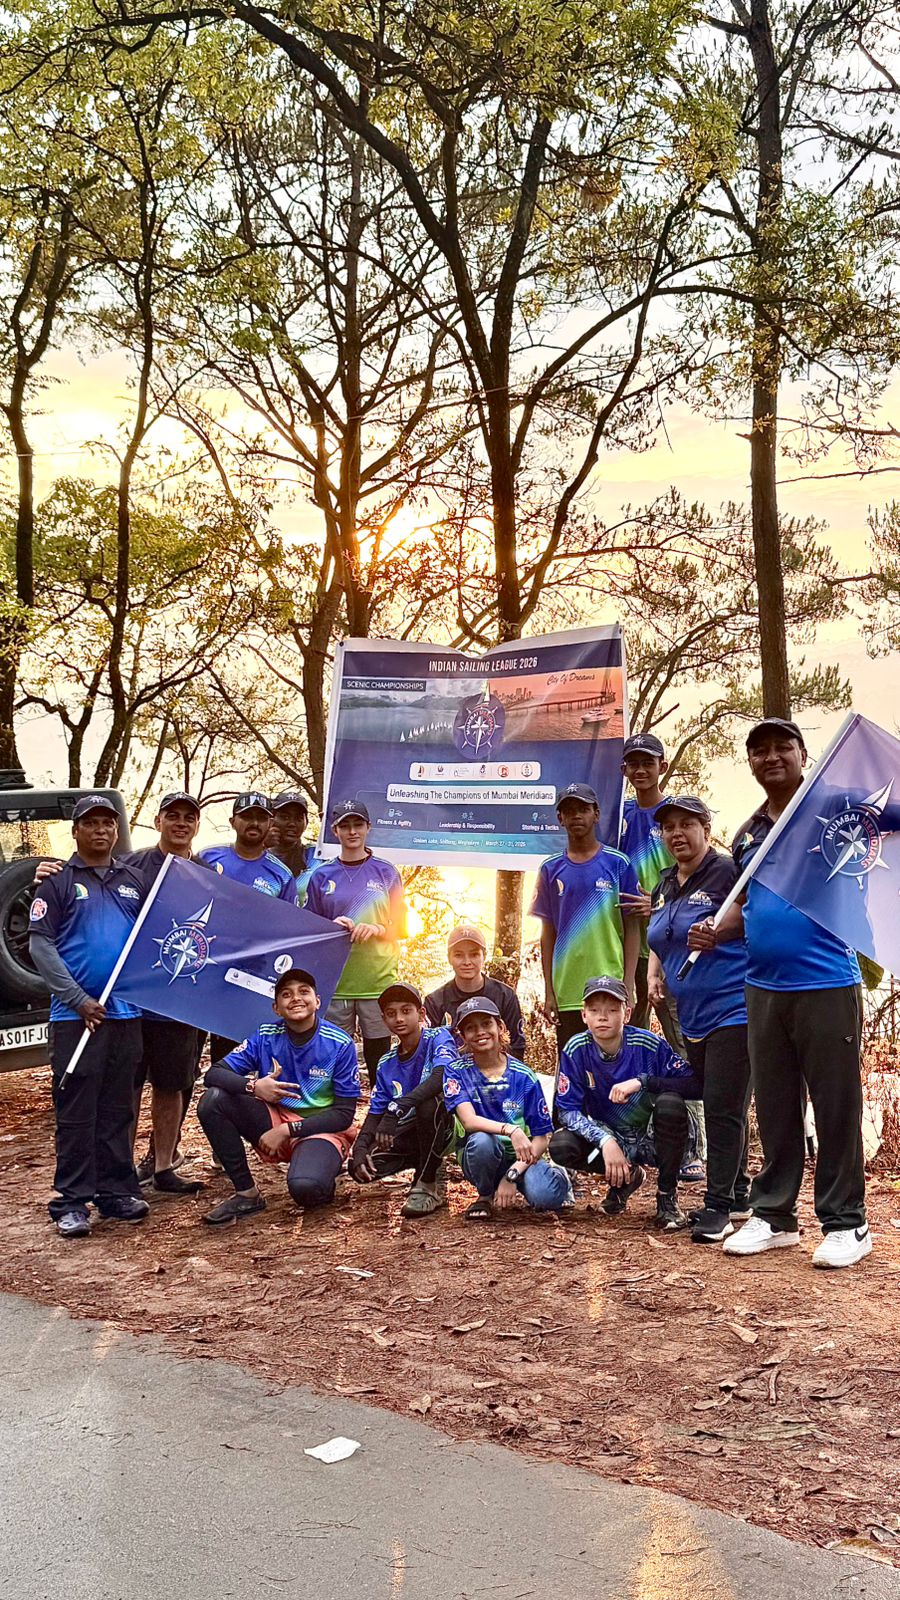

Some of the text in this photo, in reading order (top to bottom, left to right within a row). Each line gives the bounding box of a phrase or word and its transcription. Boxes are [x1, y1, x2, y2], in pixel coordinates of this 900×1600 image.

[428, 656, 538, 672] INDIAN SAILING LEAGUE 2026
[569, 672, 595, 682] Dreams
[346, 680, 424, 690] SCENIC CHAMPIONSHIPS
[389, 788, 554, 801] Unleashing The Champions of Mumbai Meridians
[438, 821, 461, 829] Leadership
[467, 822, 496, 830] Responsibility
[825, 813, 878, 869] MUMBAI MERIDIANS
[163, 929, 207, 968] MUMBAI MERIDIANS
